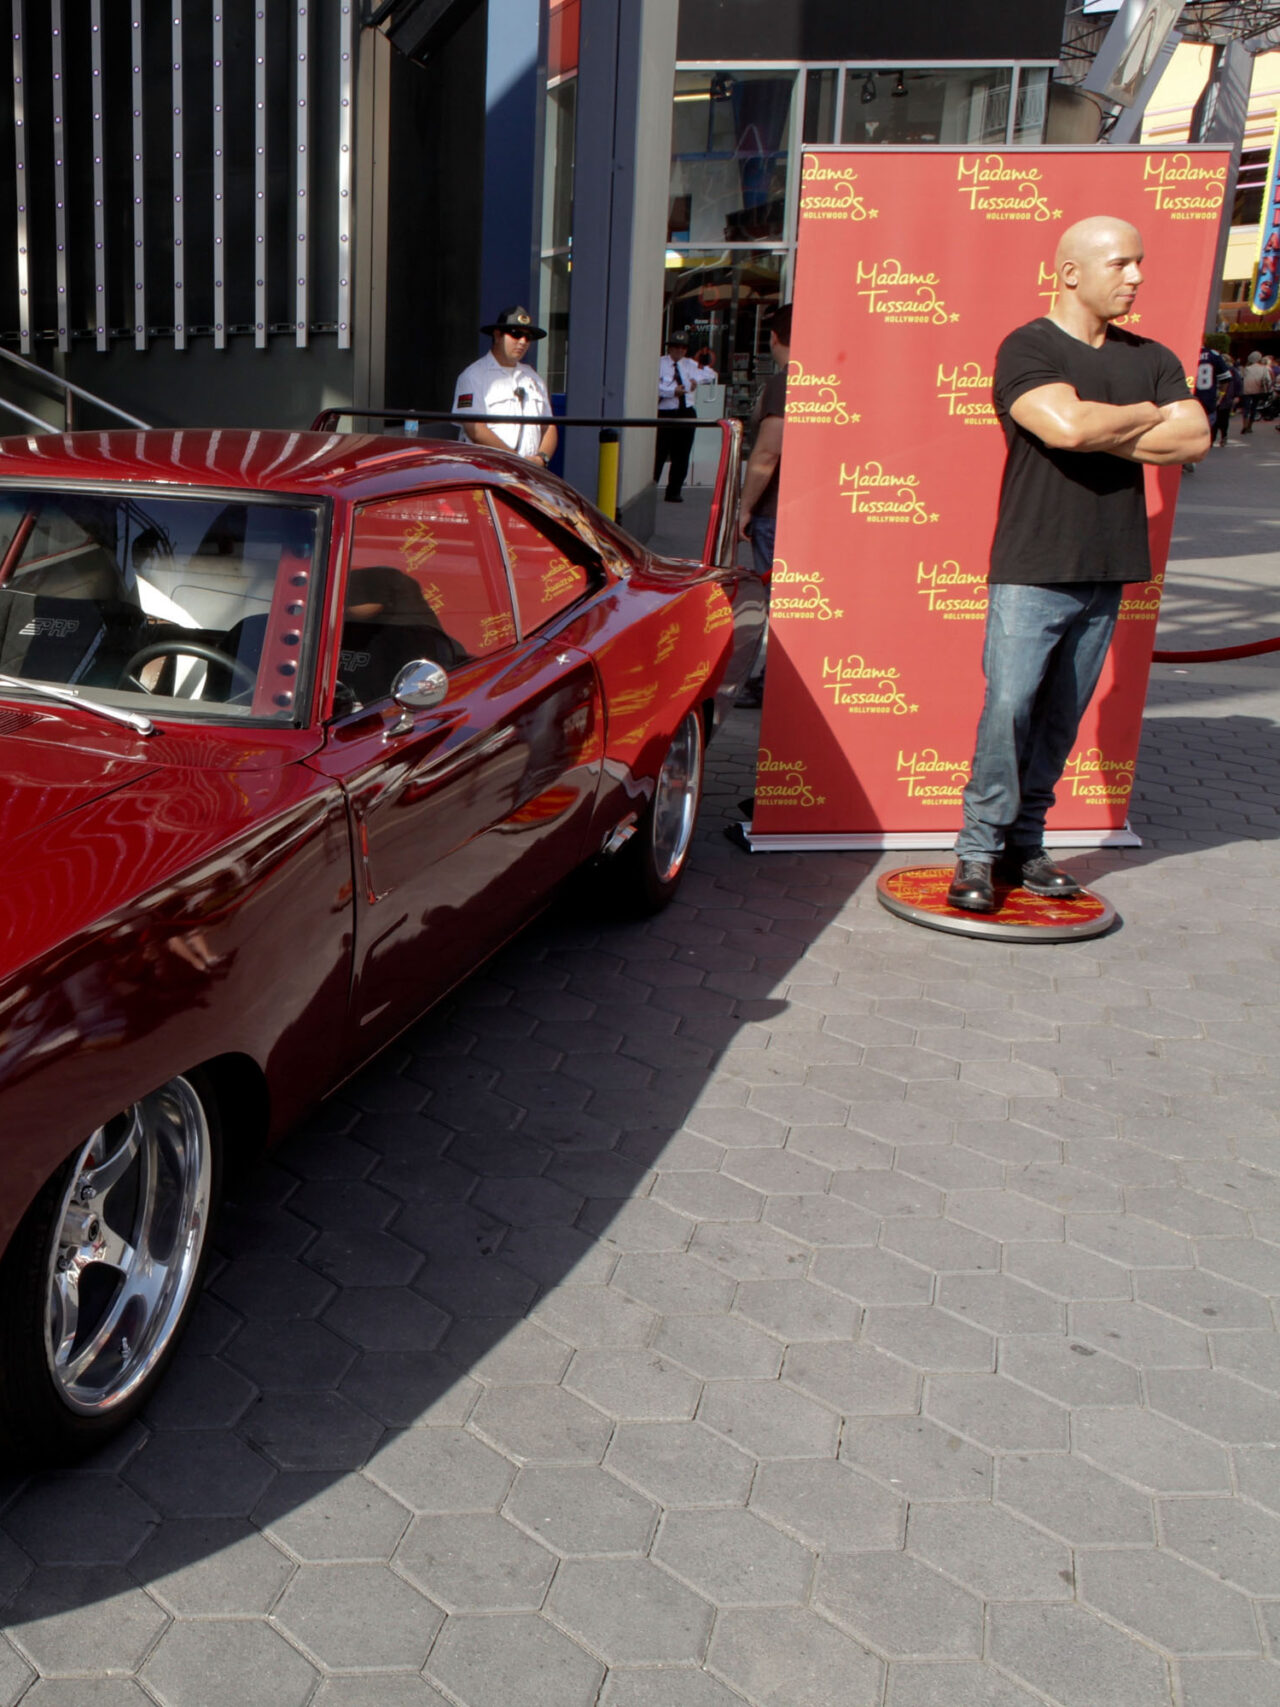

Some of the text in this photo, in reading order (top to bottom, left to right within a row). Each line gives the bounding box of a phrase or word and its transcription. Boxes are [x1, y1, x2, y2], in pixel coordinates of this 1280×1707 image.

[802, 153, 858, 180] dame
[957, 154, 1043, 184] Madame
[1144, 153, 1227, 184] Madame
[800, 182, 866, 221] ssauds
[958, 182, 1051, 221] Tussauds
[1144, 181, 1225, 210] Tussaud
[803, 211, 848, 219] HOLLYWOOD
[986, 212, 1031, 220] HOLLYWOOD
[1170, 211, 1218, 220] HOLLYWOOD
[856, 258, 940, 288] Madame
[857, 286, 948, 325] Tussauds
[884, 315, 930, 323] HOLLYWOOD
[786, 360, 841, 386] dame
[936, 361, 994, 391] Mada
[785, 386, 850, 425] ssauds
[937, 392, 996, 416] Tussa
[787, 415, 832, 424] HOLLYWOOD
[839, 461, 920, 489] Madame
[840, 487, 928, 525] Tussauds
[866, 515, 911, 523] HOLLYWOOD
[771, 558, 825, 583] dame
[770, 584, 832, 621] ssauds
[917, 585, 989, 612] Tussaud
[772, 611, 815, 619] HOLLYWOOD
[822, 654, 900, 682] Madame
[823, 680, 908, 715] Tussauds
[756, 748, 808, 772] dame
[896, 748, 971, 775] Madame
[754, 772, 815, 807] ssauds
[897, 772, 970, 797] Tussaud
[1062, 772, 1134, 797] Tussaud
[756, 798, 798, 806] HOLLYWOOD
[921, 798, 964, 806] HOLLYWOOD
[1085, 798, 1127, 806] HOLLYWOOD
